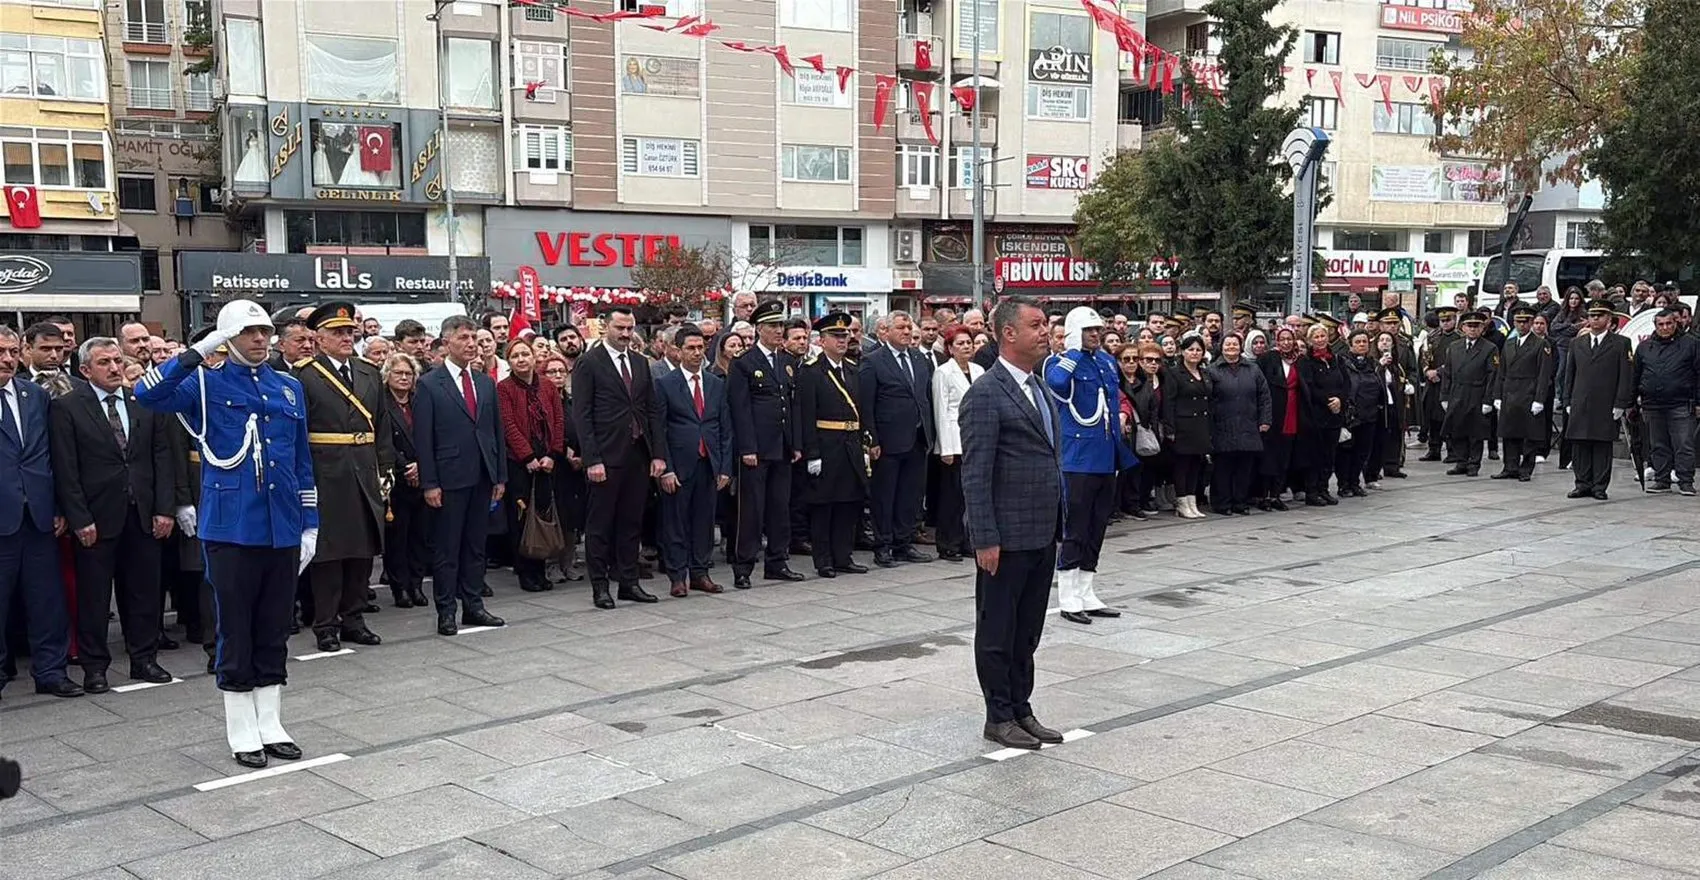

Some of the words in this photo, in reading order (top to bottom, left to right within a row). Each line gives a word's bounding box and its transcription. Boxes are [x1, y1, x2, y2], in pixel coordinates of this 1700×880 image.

[1050, 157, 1087, 178] SRC
[1050, 177, 1086, 189] KURSU
[1002, 239, 1066, 252] İSKENDER
[1010, 258, 1065, 281] BÜYÜK
[1369, 260, 1431, 275] LOTA
[212, 274, 290, 289] Patisserie
[777, 271, 848, 288] DenizBank
